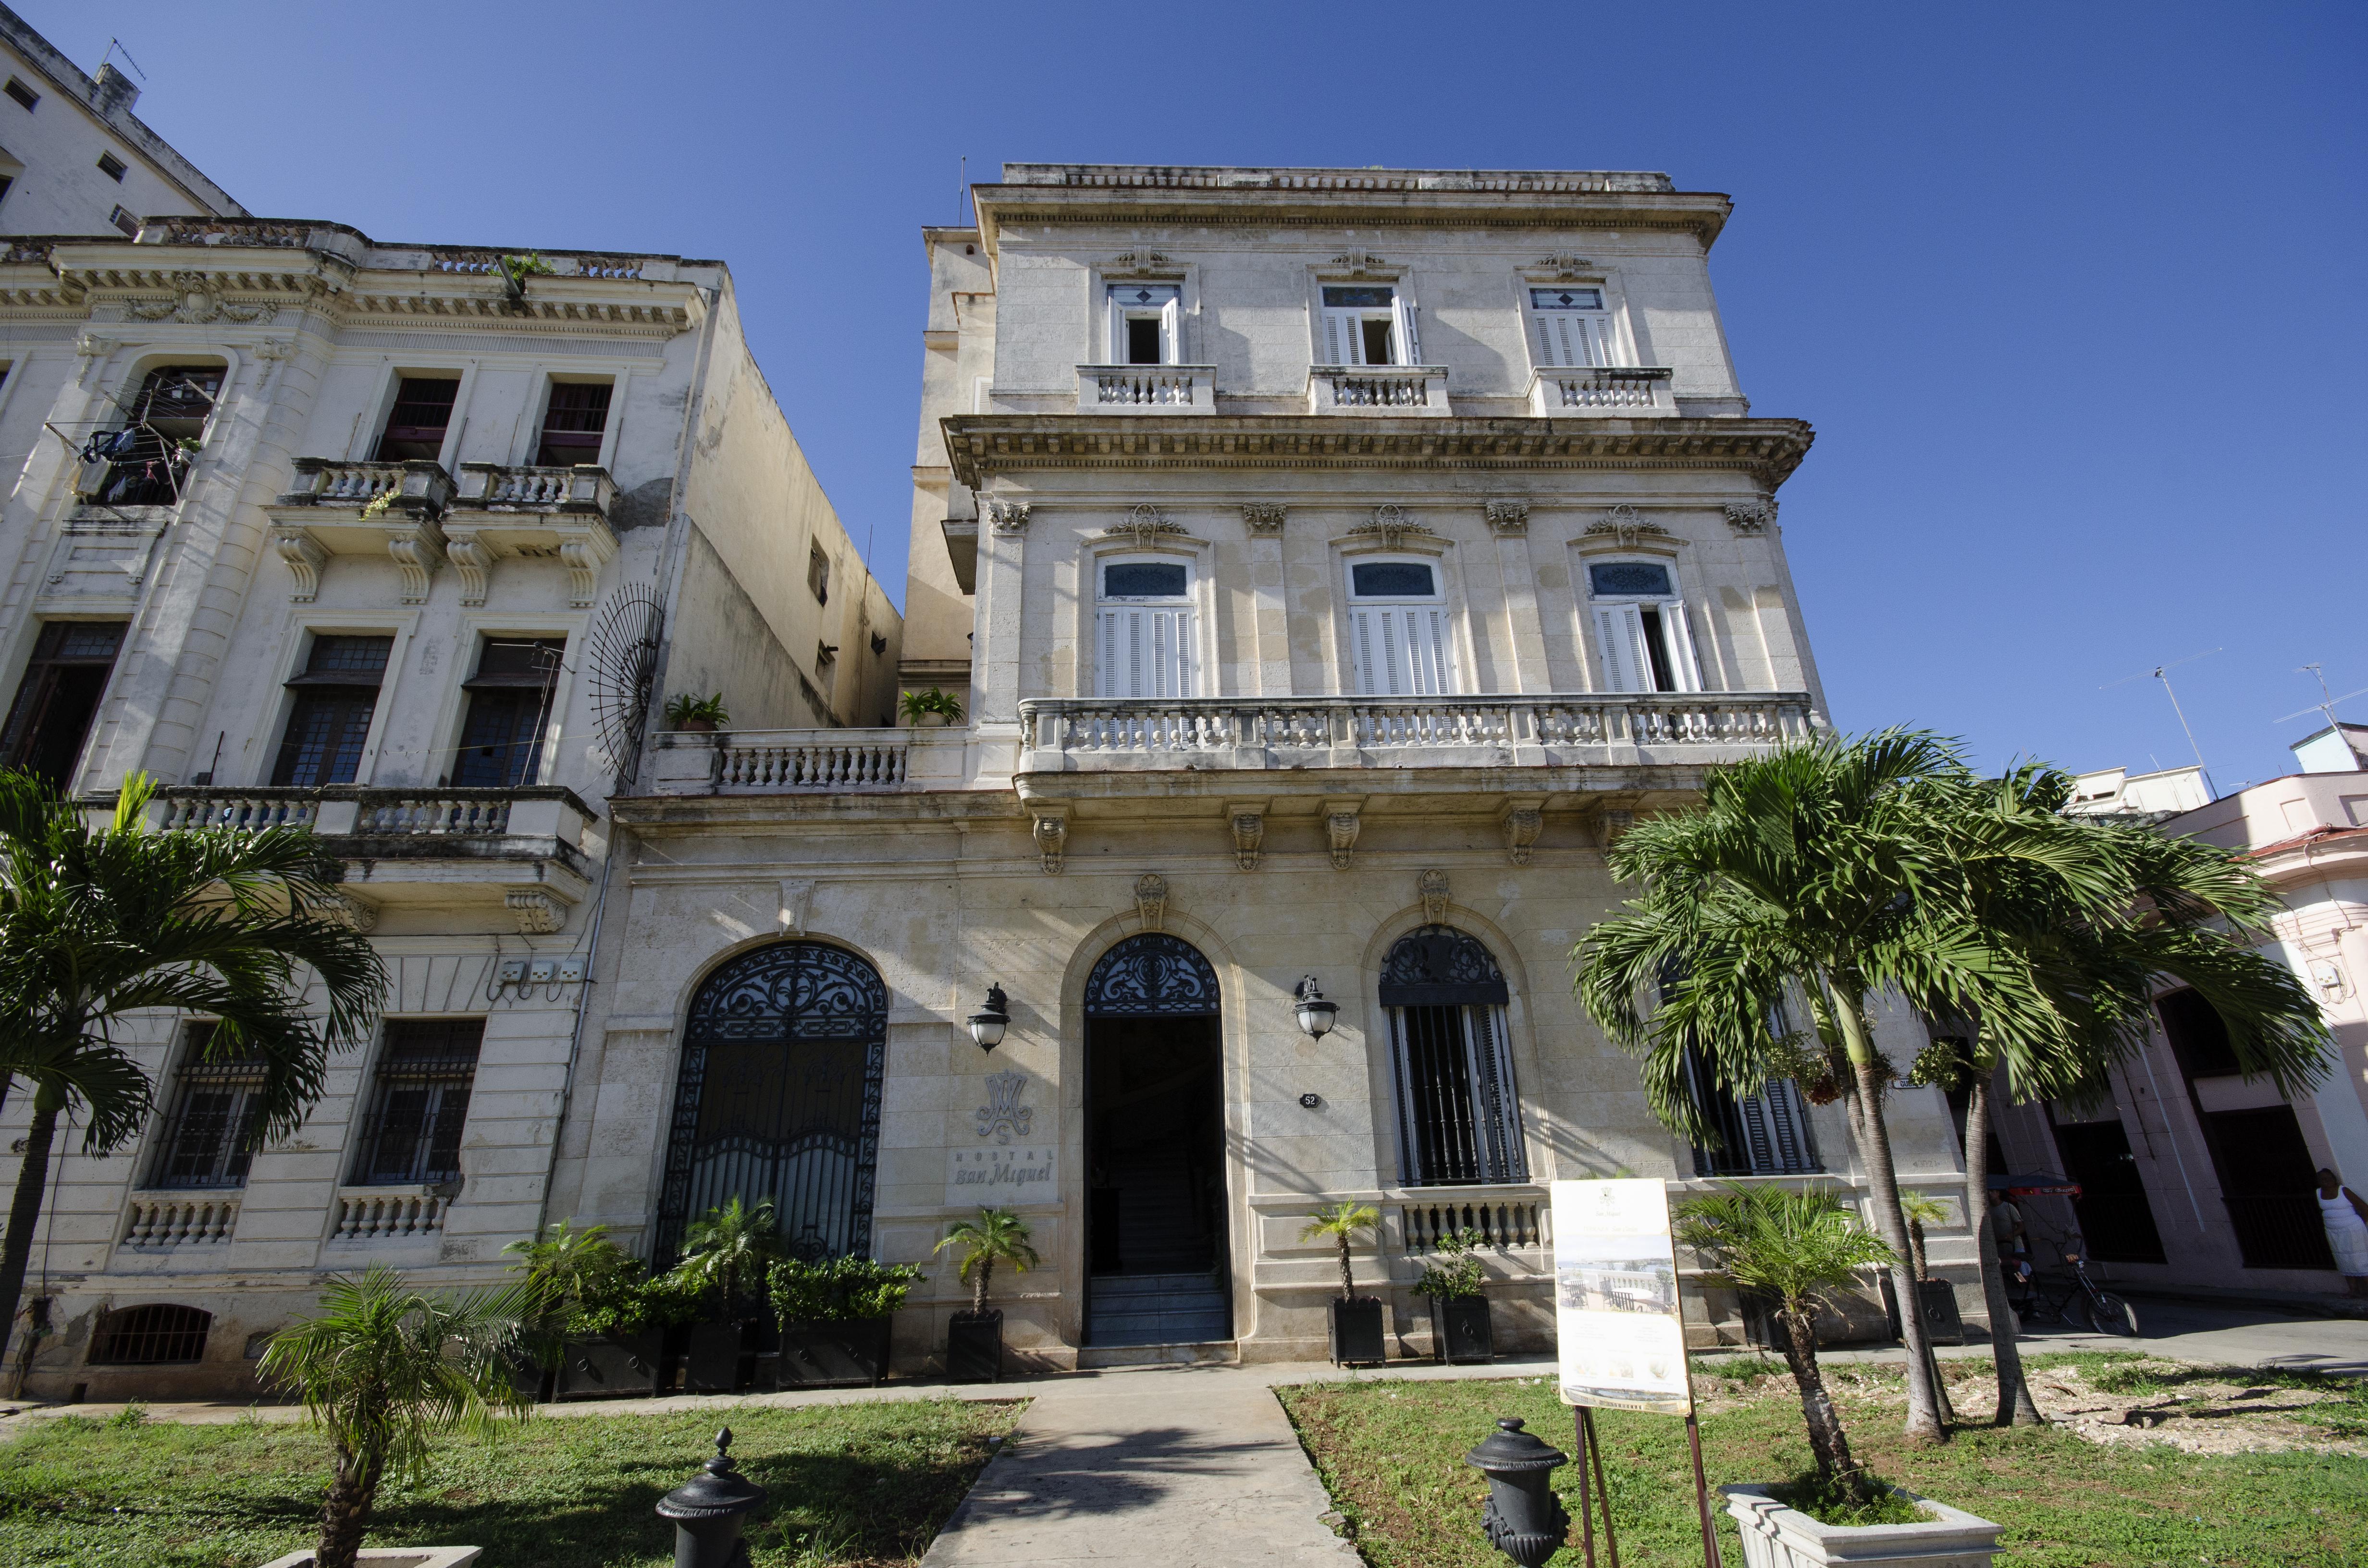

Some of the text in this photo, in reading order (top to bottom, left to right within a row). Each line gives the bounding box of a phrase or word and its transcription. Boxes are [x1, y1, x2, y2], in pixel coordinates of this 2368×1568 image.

[1305, 1096, 1315, 1105] 52
[956, 1151, 1053, 1162] HOSTAL
[956, 1162, 1051, 1186] San Miguel
